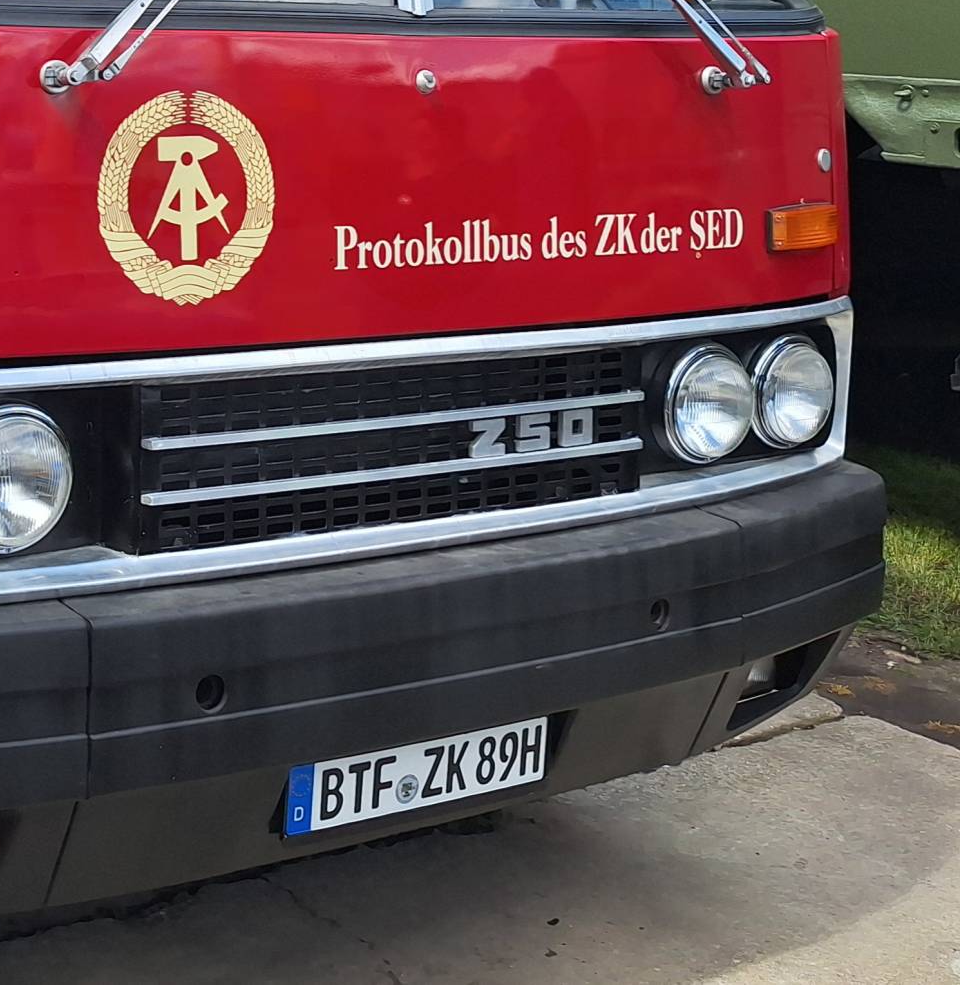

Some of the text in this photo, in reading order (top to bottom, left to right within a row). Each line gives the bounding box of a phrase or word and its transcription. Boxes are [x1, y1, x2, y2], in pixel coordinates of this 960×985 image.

[334, 208, 744, 270] Protokollbus des ZK der SED
[469, 407, 593, 459] 250
[293, 725, 542, 822] D BTF ZK 89H
